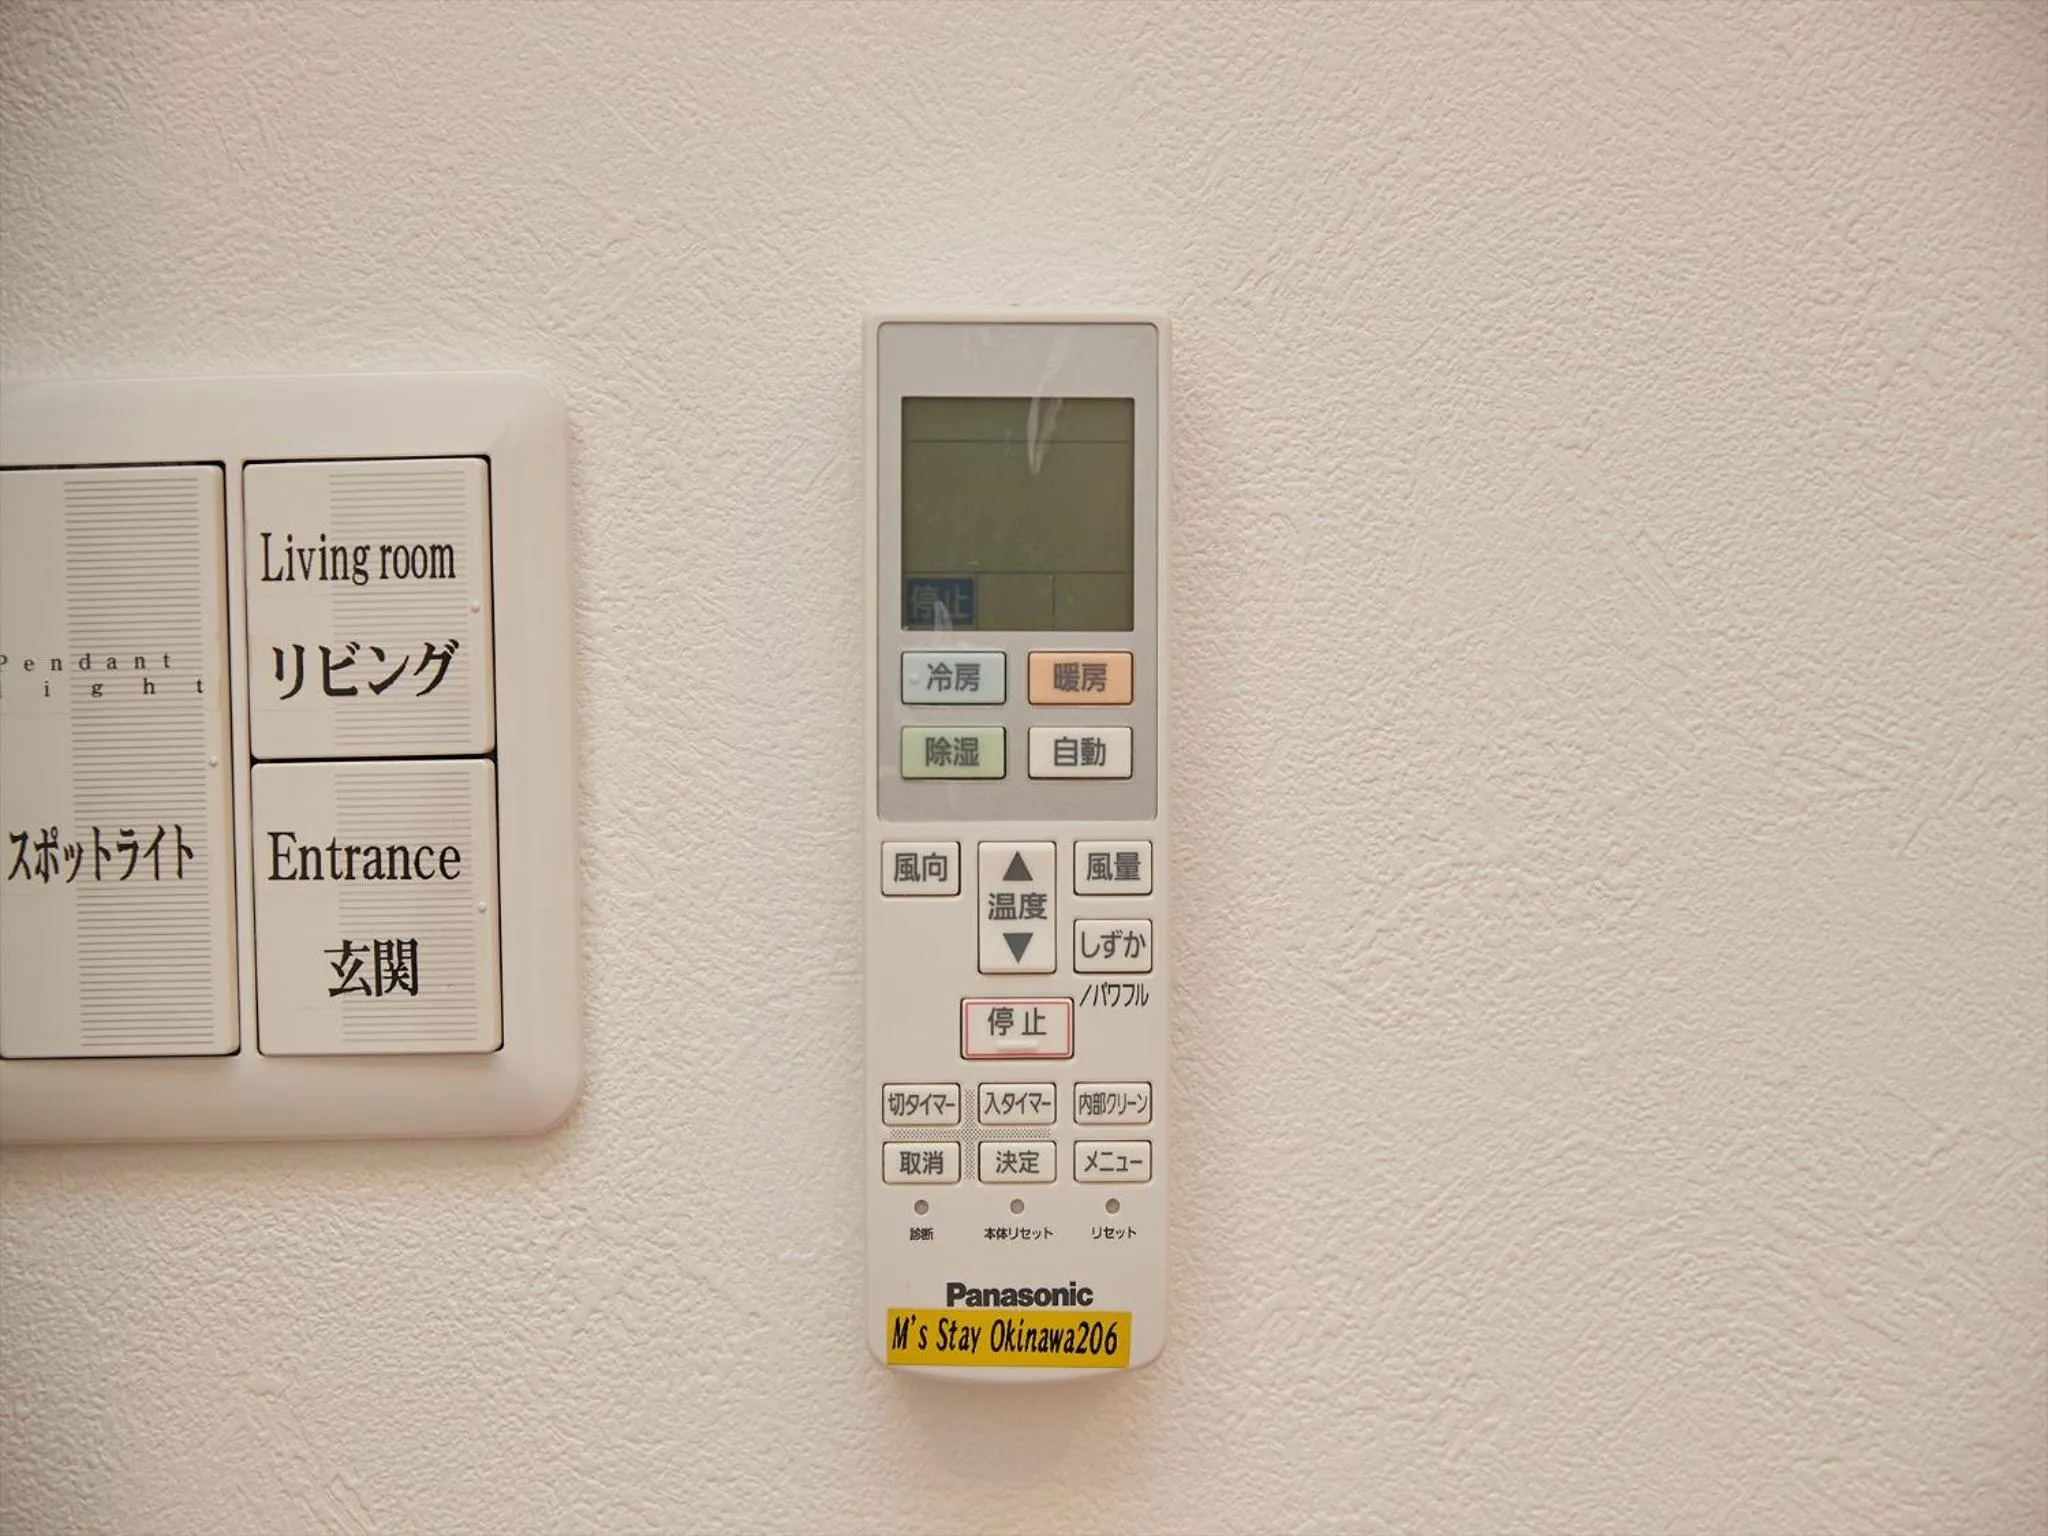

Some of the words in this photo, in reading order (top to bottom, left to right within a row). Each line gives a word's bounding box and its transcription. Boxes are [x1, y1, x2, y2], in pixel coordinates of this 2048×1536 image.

[260, 532, 371, 587] Living
[379, 543, 456, 580] room
[910, 585, 971, 620] 停止
[272, 638, 460, 700] リビング
[926, 662, 981, 693] 冷房
[1053, 662, 1108, 693] 暖房
[0, 677, 204, 699] ight
[925, 736, 980, 767] 除湿
[1053, 735, 1107, 767] 自動
[7, 823, 194, 884] スポットライト
[267, 831, 461, 881] Entrance
[893, 852, 948, 883] 風向
[1086, 851, 1141, 881] 風量
[987, 891, 1048, 921] 温度
[1081, 929, 1147, 959] しずか
[323, 937, 419, 998] 玄関
[887, 1092, 956, 1117] 切タイマー
[984, 1091, 1052, 1115] 入タイマー
[1079, 1091, 1148, 1116] 内部クリーン
[899, 1150, 944, 1176] 取消
[995, 1149, 1040, 1174] 決定
[1084, 1150, 1143, 1173] メニュー
[909, 1227, 934, 1241] 診断
[983, 1226, 1054, 1241] 本体リセット
[1091, 1225, 1137, 1240] リセット
[946, 1281, 1094, 1308] Panasonic
[935, 1317, 982, 1354] Stay
[990, 1318, 1118, 1356] Okinawa206
